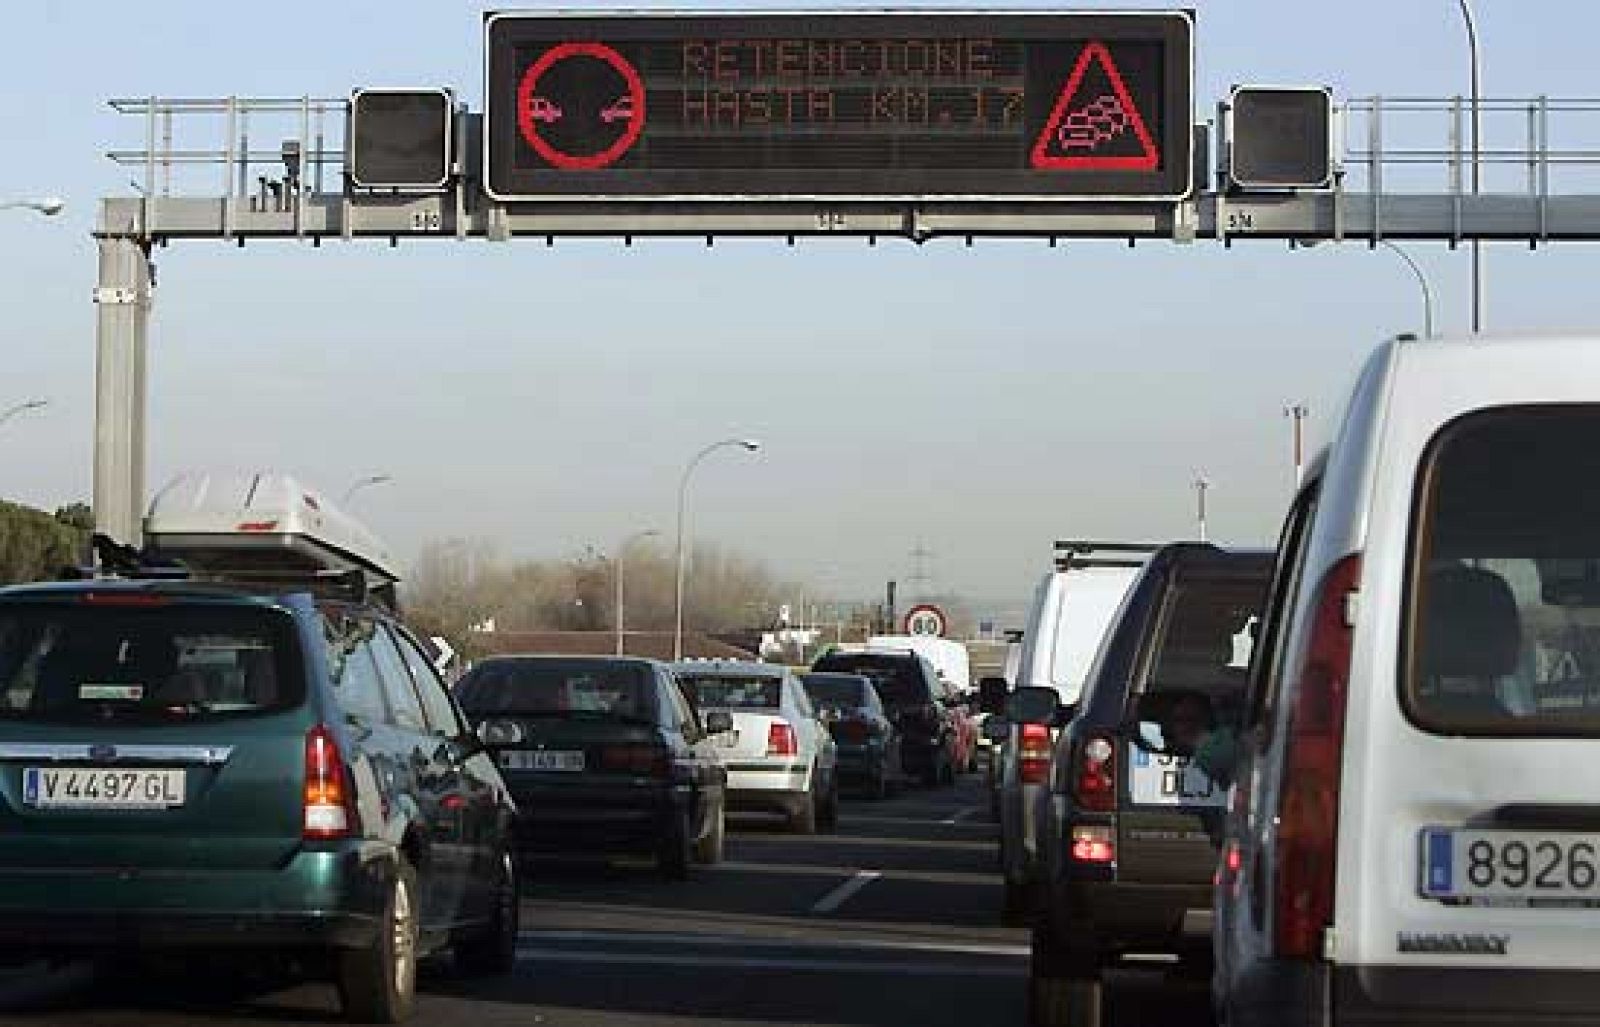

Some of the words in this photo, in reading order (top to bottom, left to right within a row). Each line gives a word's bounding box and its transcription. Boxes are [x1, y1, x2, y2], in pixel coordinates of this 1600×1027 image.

[683, 40, 993, 78] RETENCIONE
[683, 86, 835, 123] HASTA
[43, 772, 59, 799] V
[65, 772, 138, 799] 4497
[144, 773, 178, 801] GL
[1467, 839, 1597, 890] 8926
